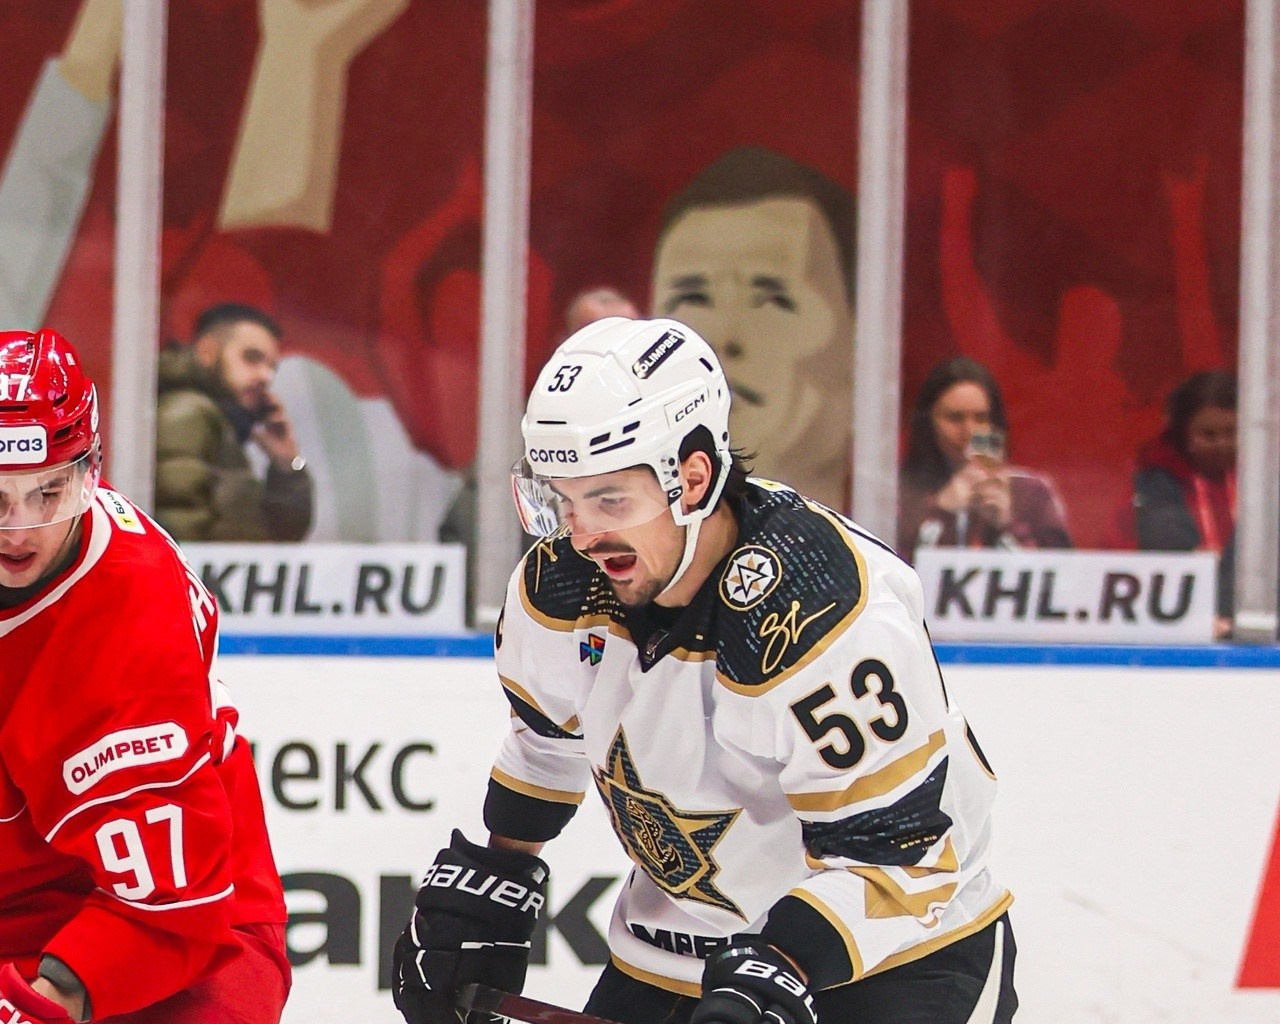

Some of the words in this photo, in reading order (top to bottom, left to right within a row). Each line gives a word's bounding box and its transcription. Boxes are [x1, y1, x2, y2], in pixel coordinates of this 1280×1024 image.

[547, 365, 583, 392] 53
[675, 394, 705, 423] CCM
[529, 448, 579, 464] согаз
[202, 563, 447, 615] KHL.RU
[934, 566, 1195, 624] KHL.RU
[788, 657, 910, 771] 53
[70, 734, 175, 784] OLIMPBET
[253, 738, 439, 814] екс
[95, 804, 188, 901] 97
